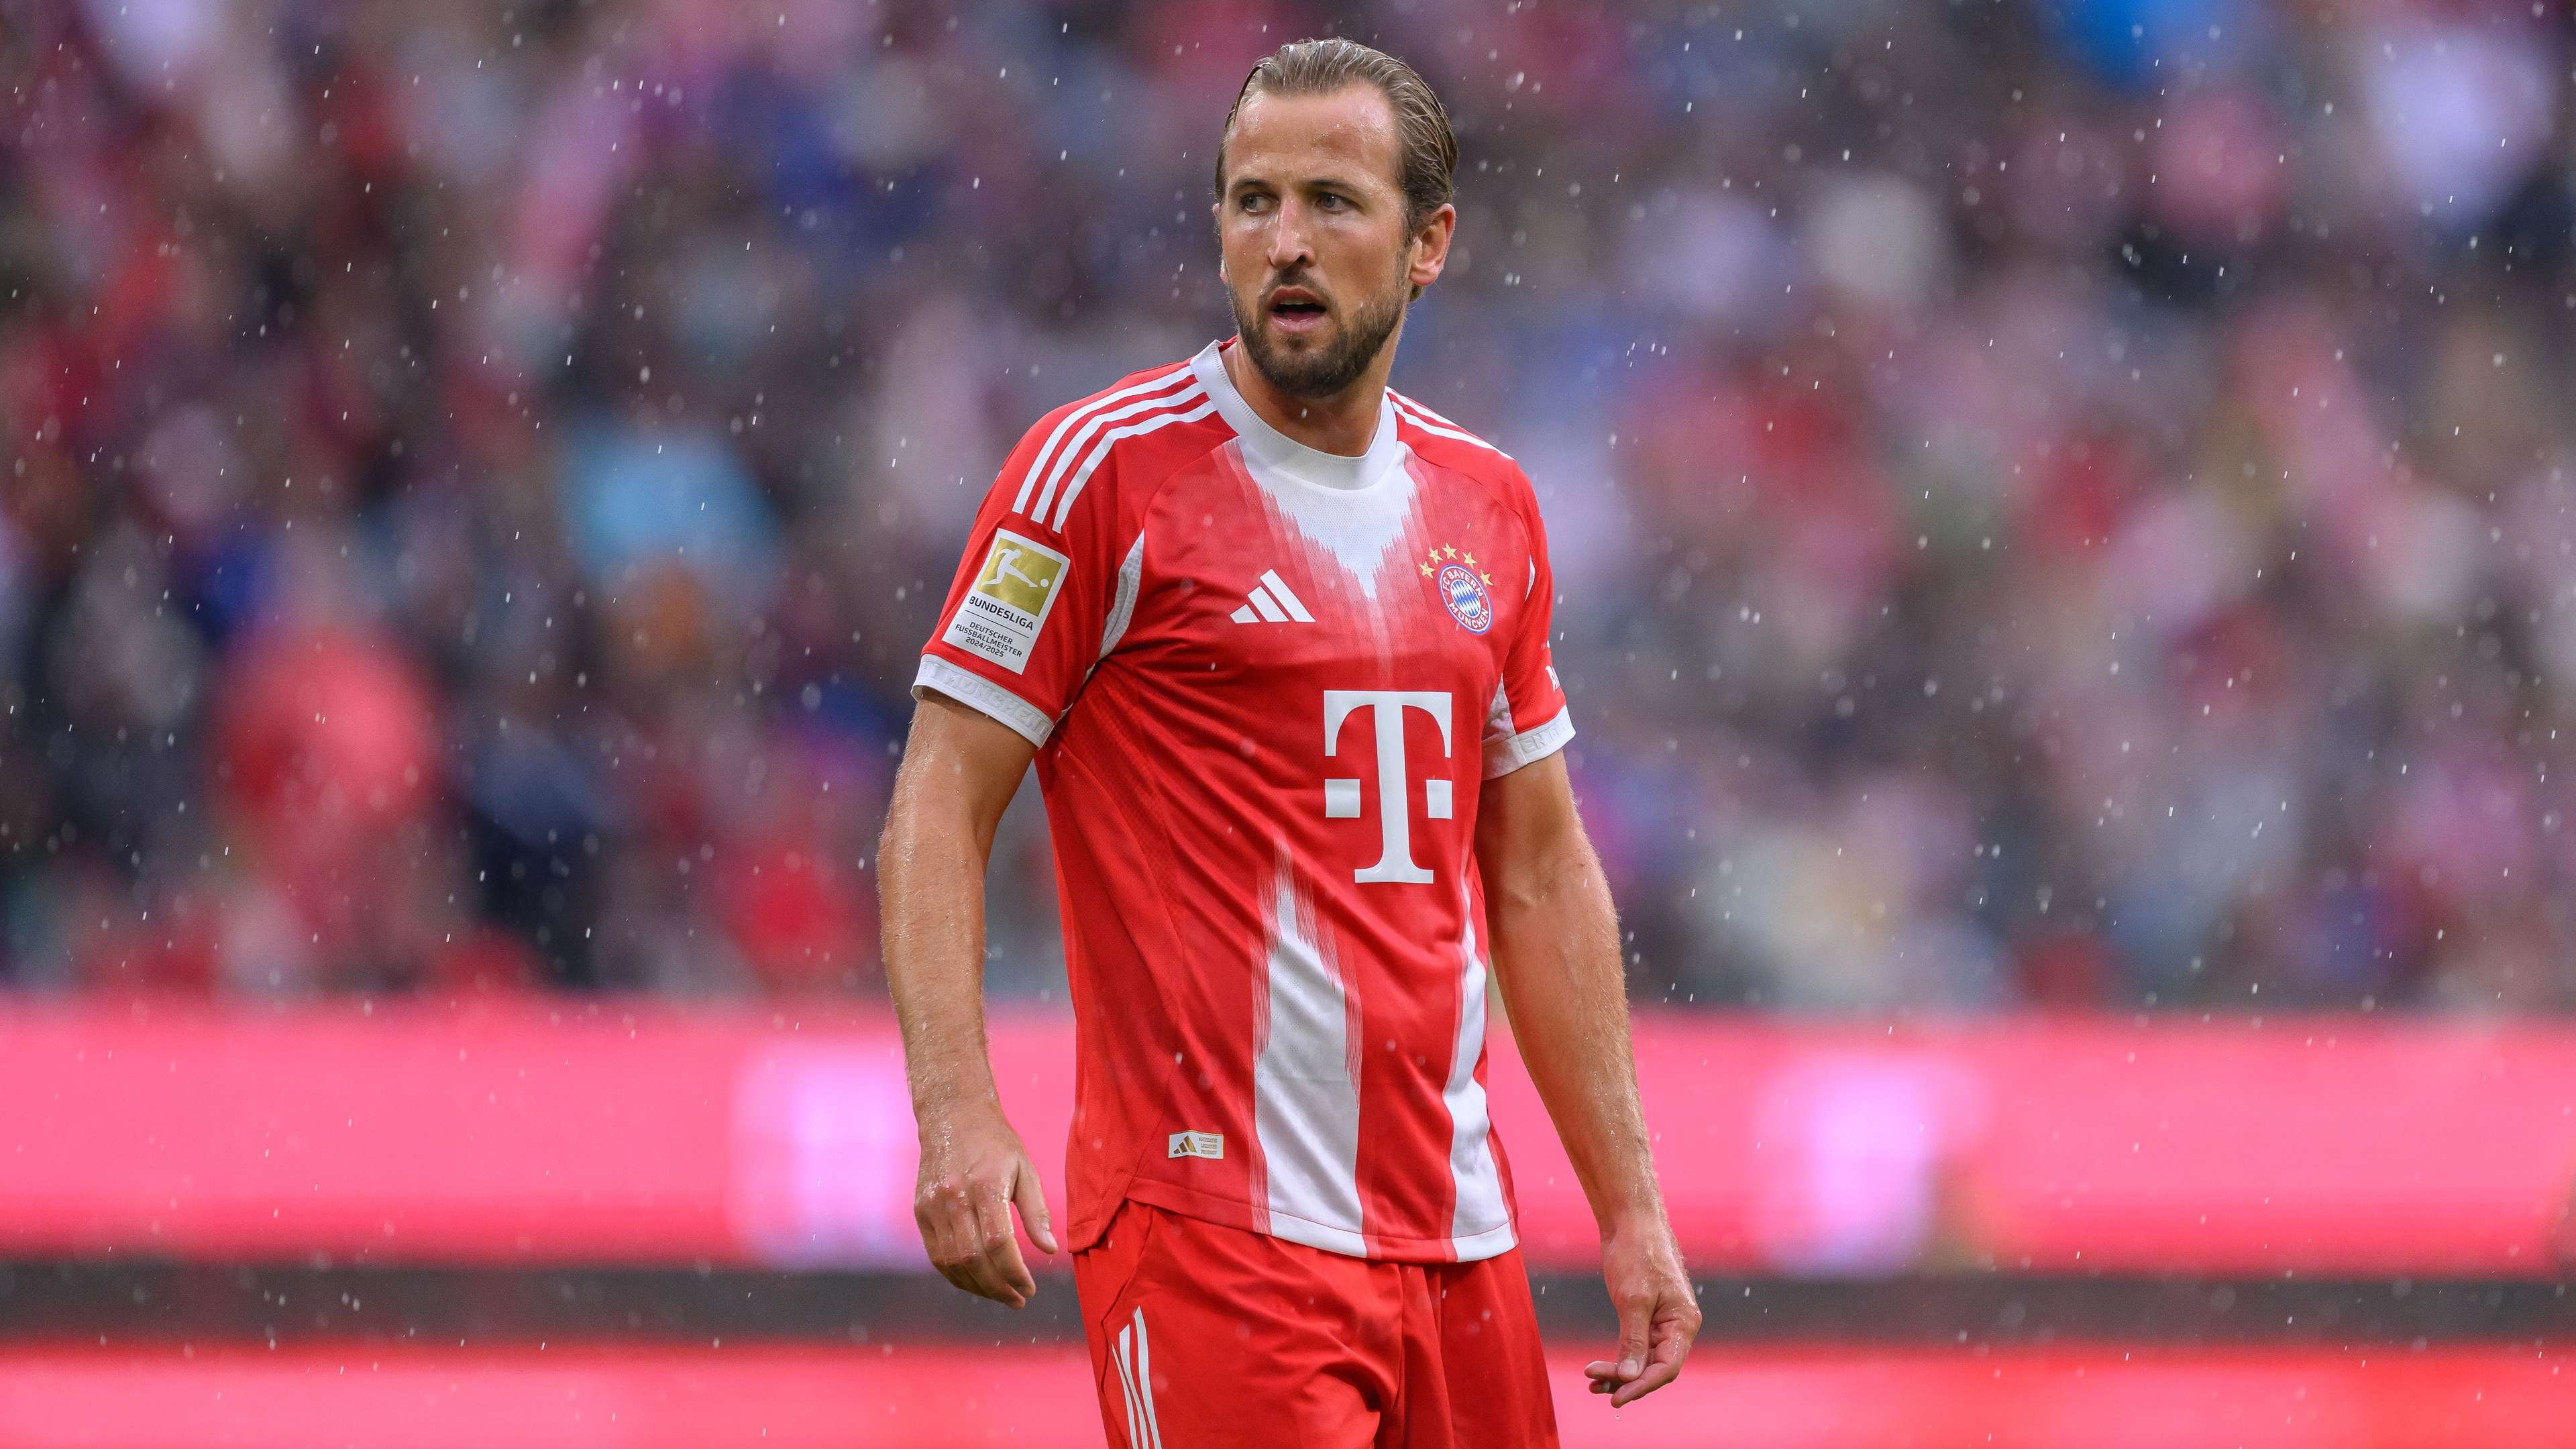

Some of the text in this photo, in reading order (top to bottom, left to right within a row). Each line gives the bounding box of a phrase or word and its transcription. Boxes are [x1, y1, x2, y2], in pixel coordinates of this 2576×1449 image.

[1442, 569, 1484, 597] FC BAYERN
[969, 596, 1034, 631] BUNDESLIGA
[955, 624, 1022, 657] FUSSBALLMEISTER
[965, 637, 1004, 657] 2024/2025
[969, 622, 1013, 645] DEUTSCHER
[1324, 690, 1452, 884] T
